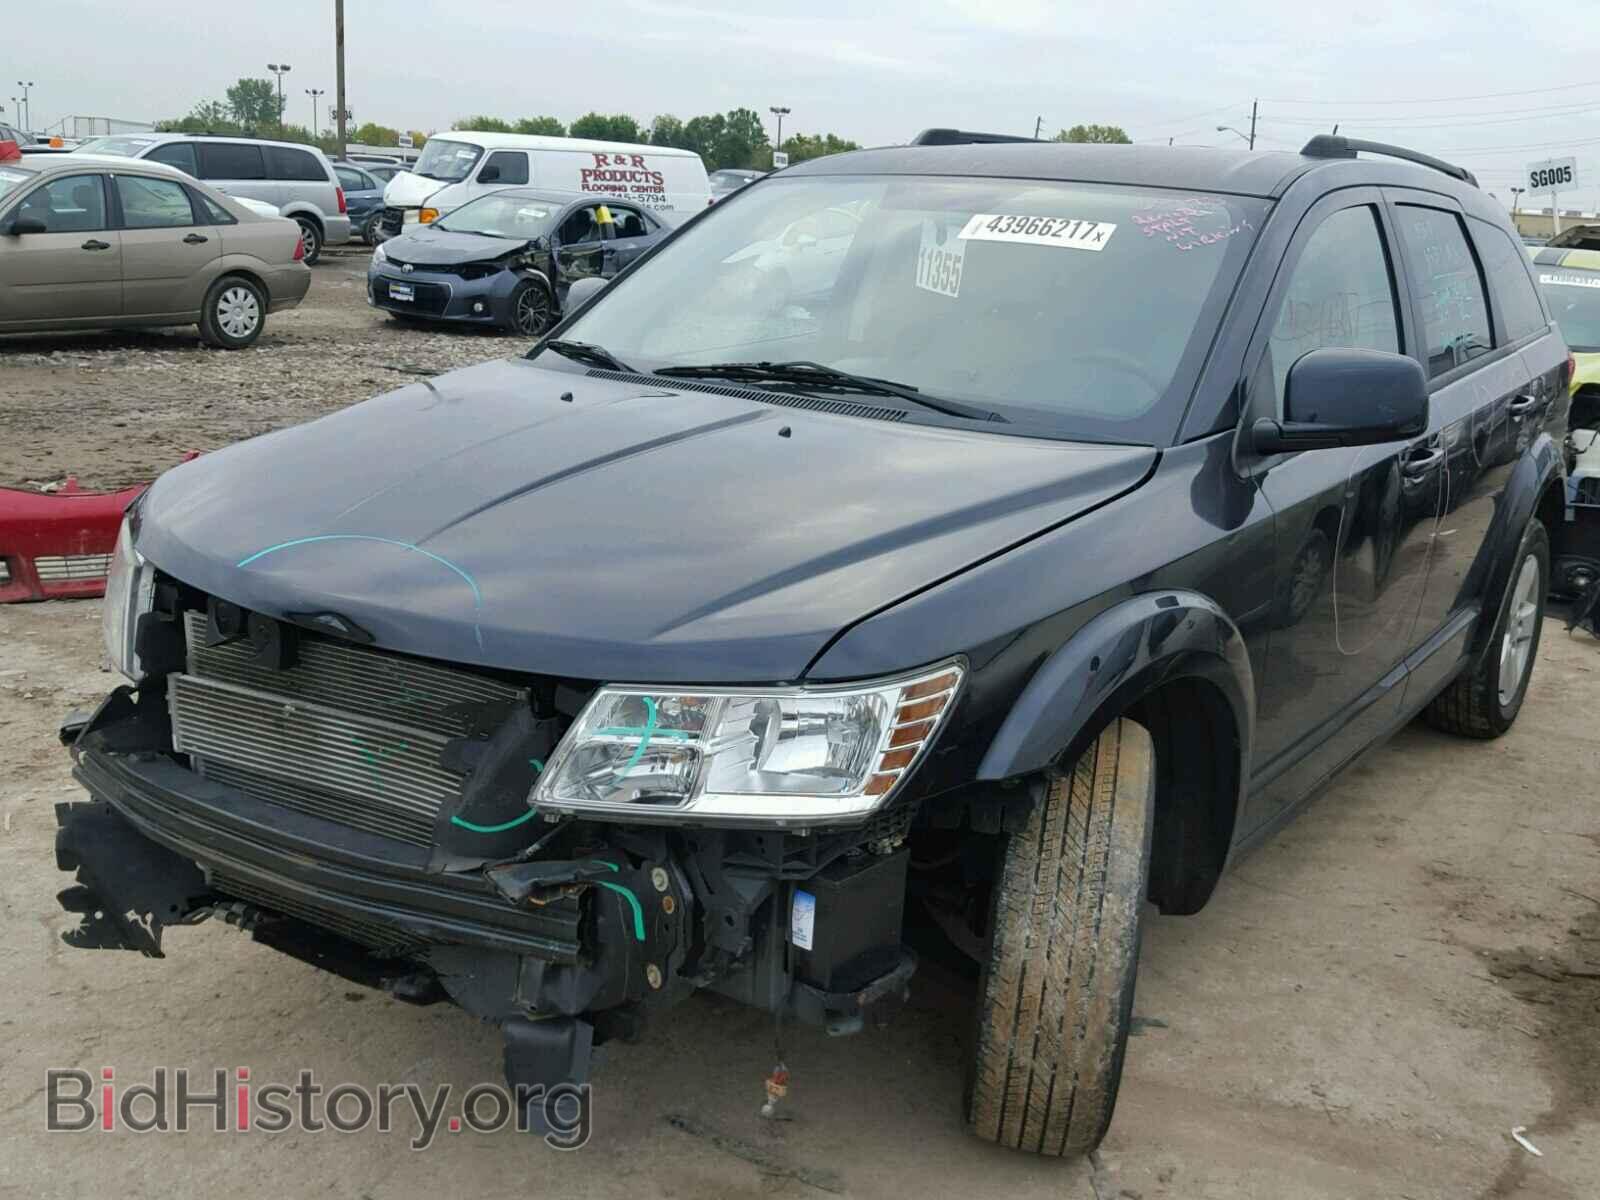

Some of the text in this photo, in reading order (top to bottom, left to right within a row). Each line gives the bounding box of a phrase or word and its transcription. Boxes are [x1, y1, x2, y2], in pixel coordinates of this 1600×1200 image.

[332, 109, 352, 120] S04
[592, 153, 648, 170] R & R
[580, 169, 664, 186] PRODUCTS
[1530, 166, 1572, 188] SG005
[581, 184, 665, 193] FLOORING CENTER
